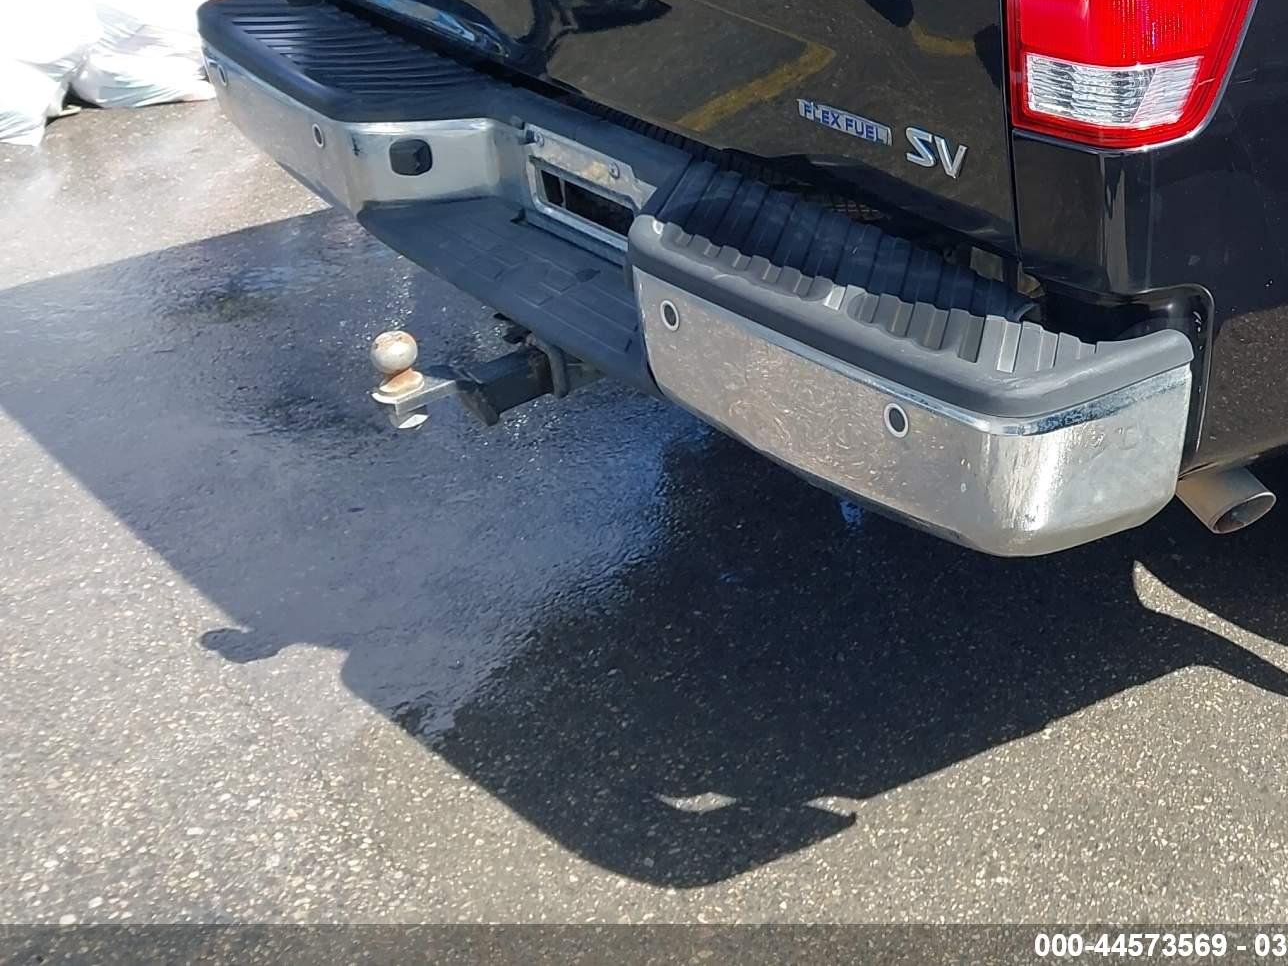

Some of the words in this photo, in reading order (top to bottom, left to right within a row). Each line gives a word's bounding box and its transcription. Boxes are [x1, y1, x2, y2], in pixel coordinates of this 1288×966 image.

[802, 100, 842, 130] FLEX
[845, 116, 886, 145] FUEL
[905, 126, 969, 180] SV
